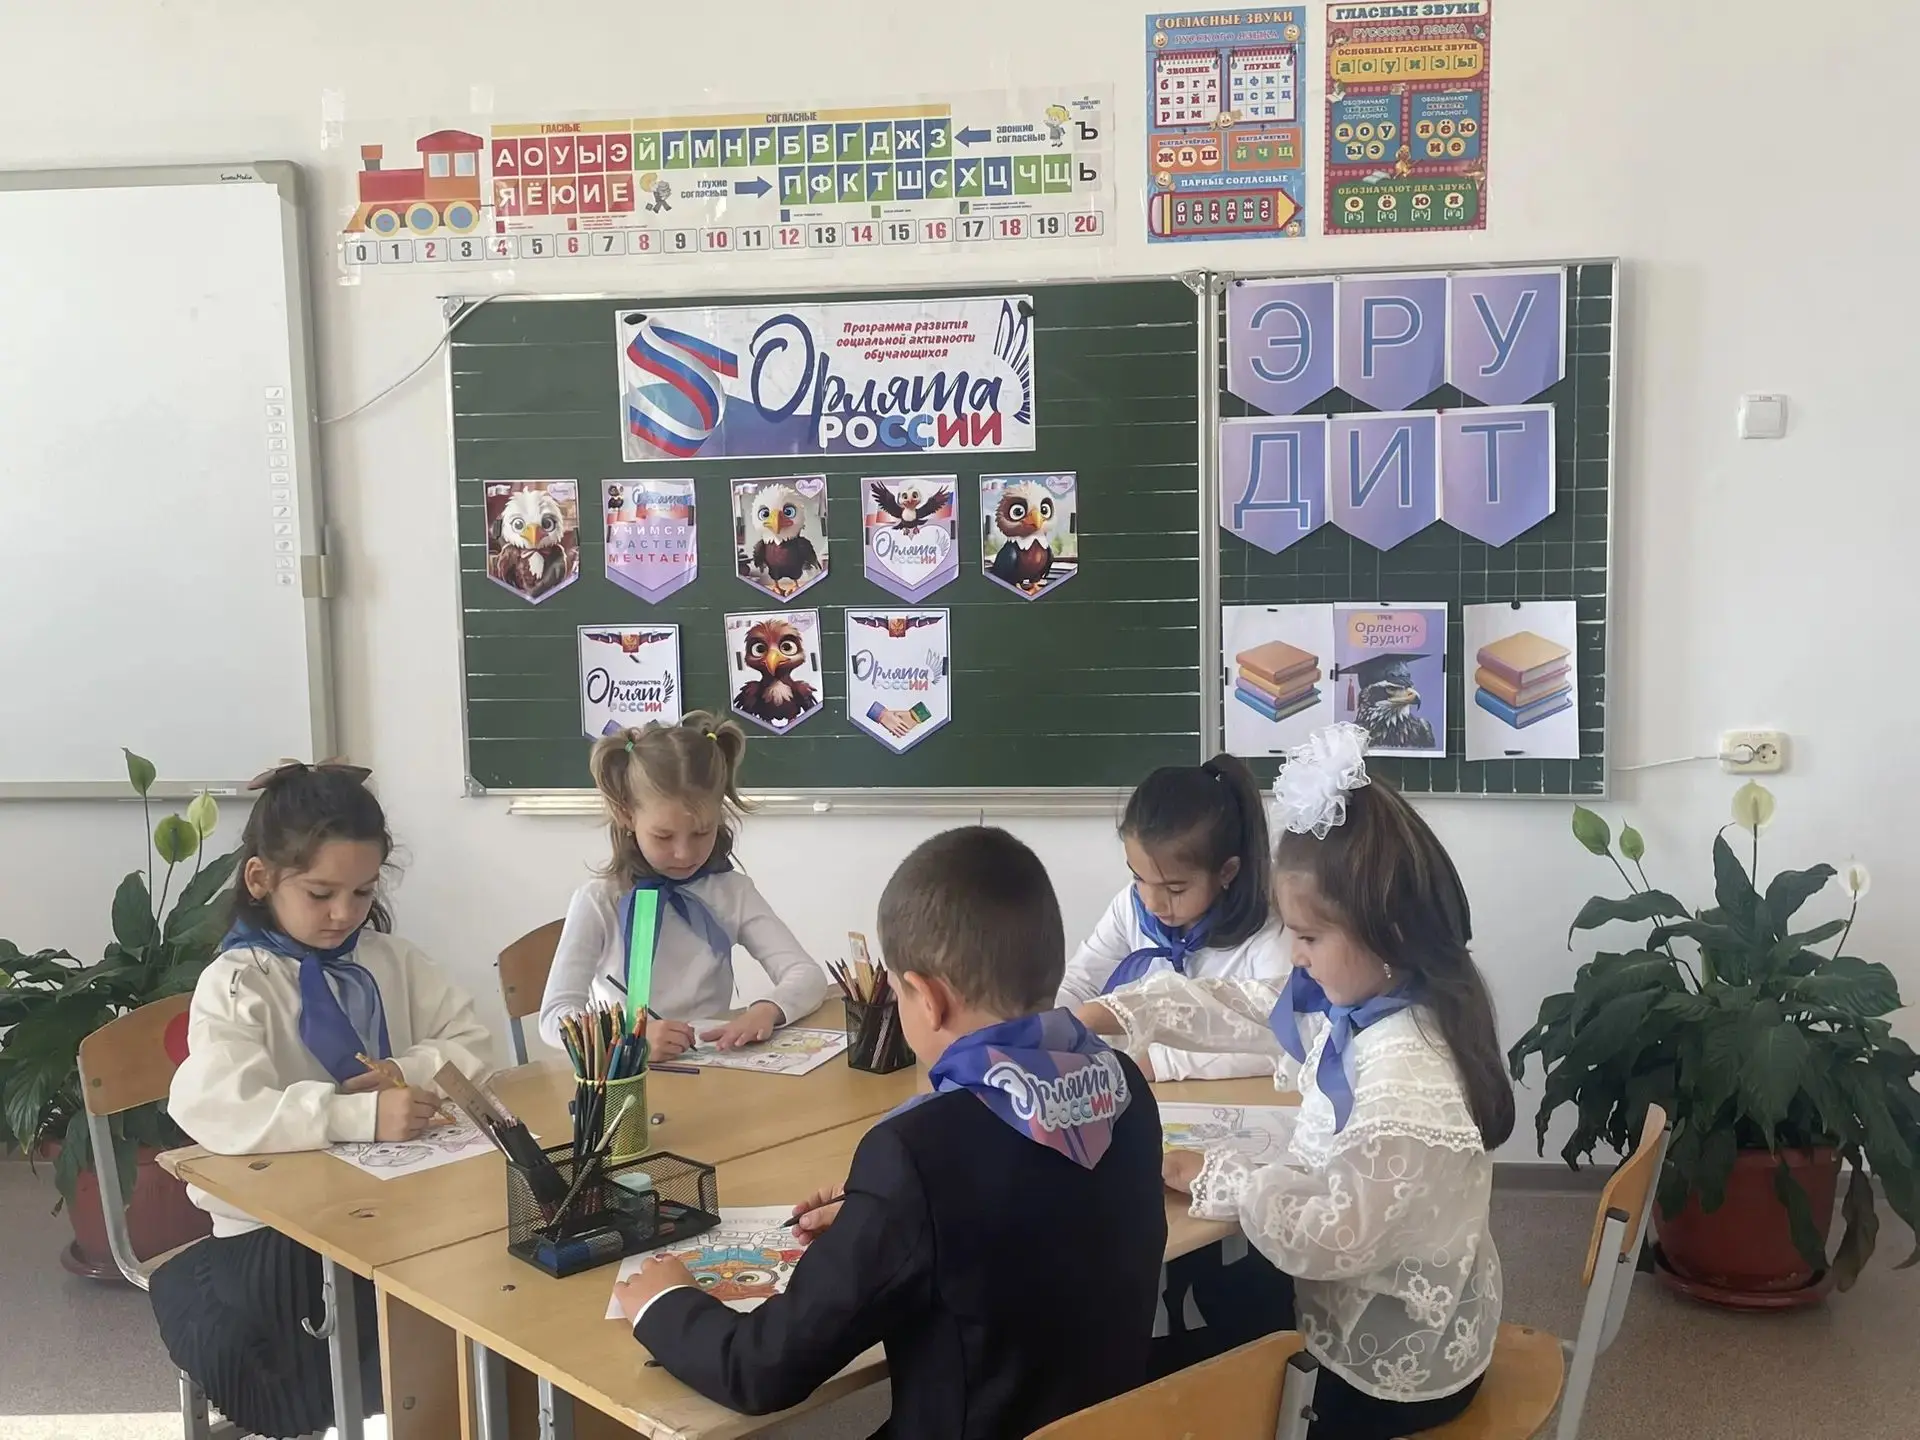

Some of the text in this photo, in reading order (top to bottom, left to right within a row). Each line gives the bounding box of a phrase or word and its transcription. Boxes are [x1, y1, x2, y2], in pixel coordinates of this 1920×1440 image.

[1335, 3, 1480, 20] ГЛАСНЫЕ ЗВУКИ
[1155, 11, 1293, 29] СОГЛАСНЫЕ ЗВУКИ
[1352, 23, 1467, 38] РУССКОГО ЯЗЫКА
[1338, 43, 1478, 56] ОСНОВНЫЕ ГЛАСНЫЕ ЗВУКИ
[1166, 66, 1210, 75] ЗВОНКИЕ
[1244, 62, 1281, 71] ГЛУХИЕ
[766, 111, 817, 124] СОГЛАСНЫЕ
[541, 123, 581, 133] ГЛАСНЫЕ
[1181, 175, 1289, 187] ПАРНЫЕ СОГЛАСНЫЕ
[1338, 183, 1472, 195] ОБОЗНАЧАЮТ ДВА ЗВУКА
[356, 215, 1097, 261] 0 1 2 3 4 5 6 7 8 9 10 11 12 13 14 15 16 17 18 19 20
[843, 320, 968, 335] Программа развития
[836, 334, 975, 348] социальной активности
[864, 349, 948, 362] обучающихся
[749, 313, 1003, 443] Орлята
[819, 413, 1002, 448] РОССИИ
[612, 526, 685, 535] УЧИМСЯ
[616, 540, 686, 548] РАСТЕМ
[876, 531, 936, 560] Орлята
[609, 554, 694, 562] МЕЧТАЕМ
[1355, 622, 1419, 634] Орленок
[1363, 635, 1412, 646] эрудит
[855, 649, 928, 685] Орлята
[586, 667, 661, 707] Орлят
[610, 702, 661, 712] РОССИИ
[985, 1066, 1110, 1120] Орлята
[1047, 1093, 1113, 1126] РОССИИ
